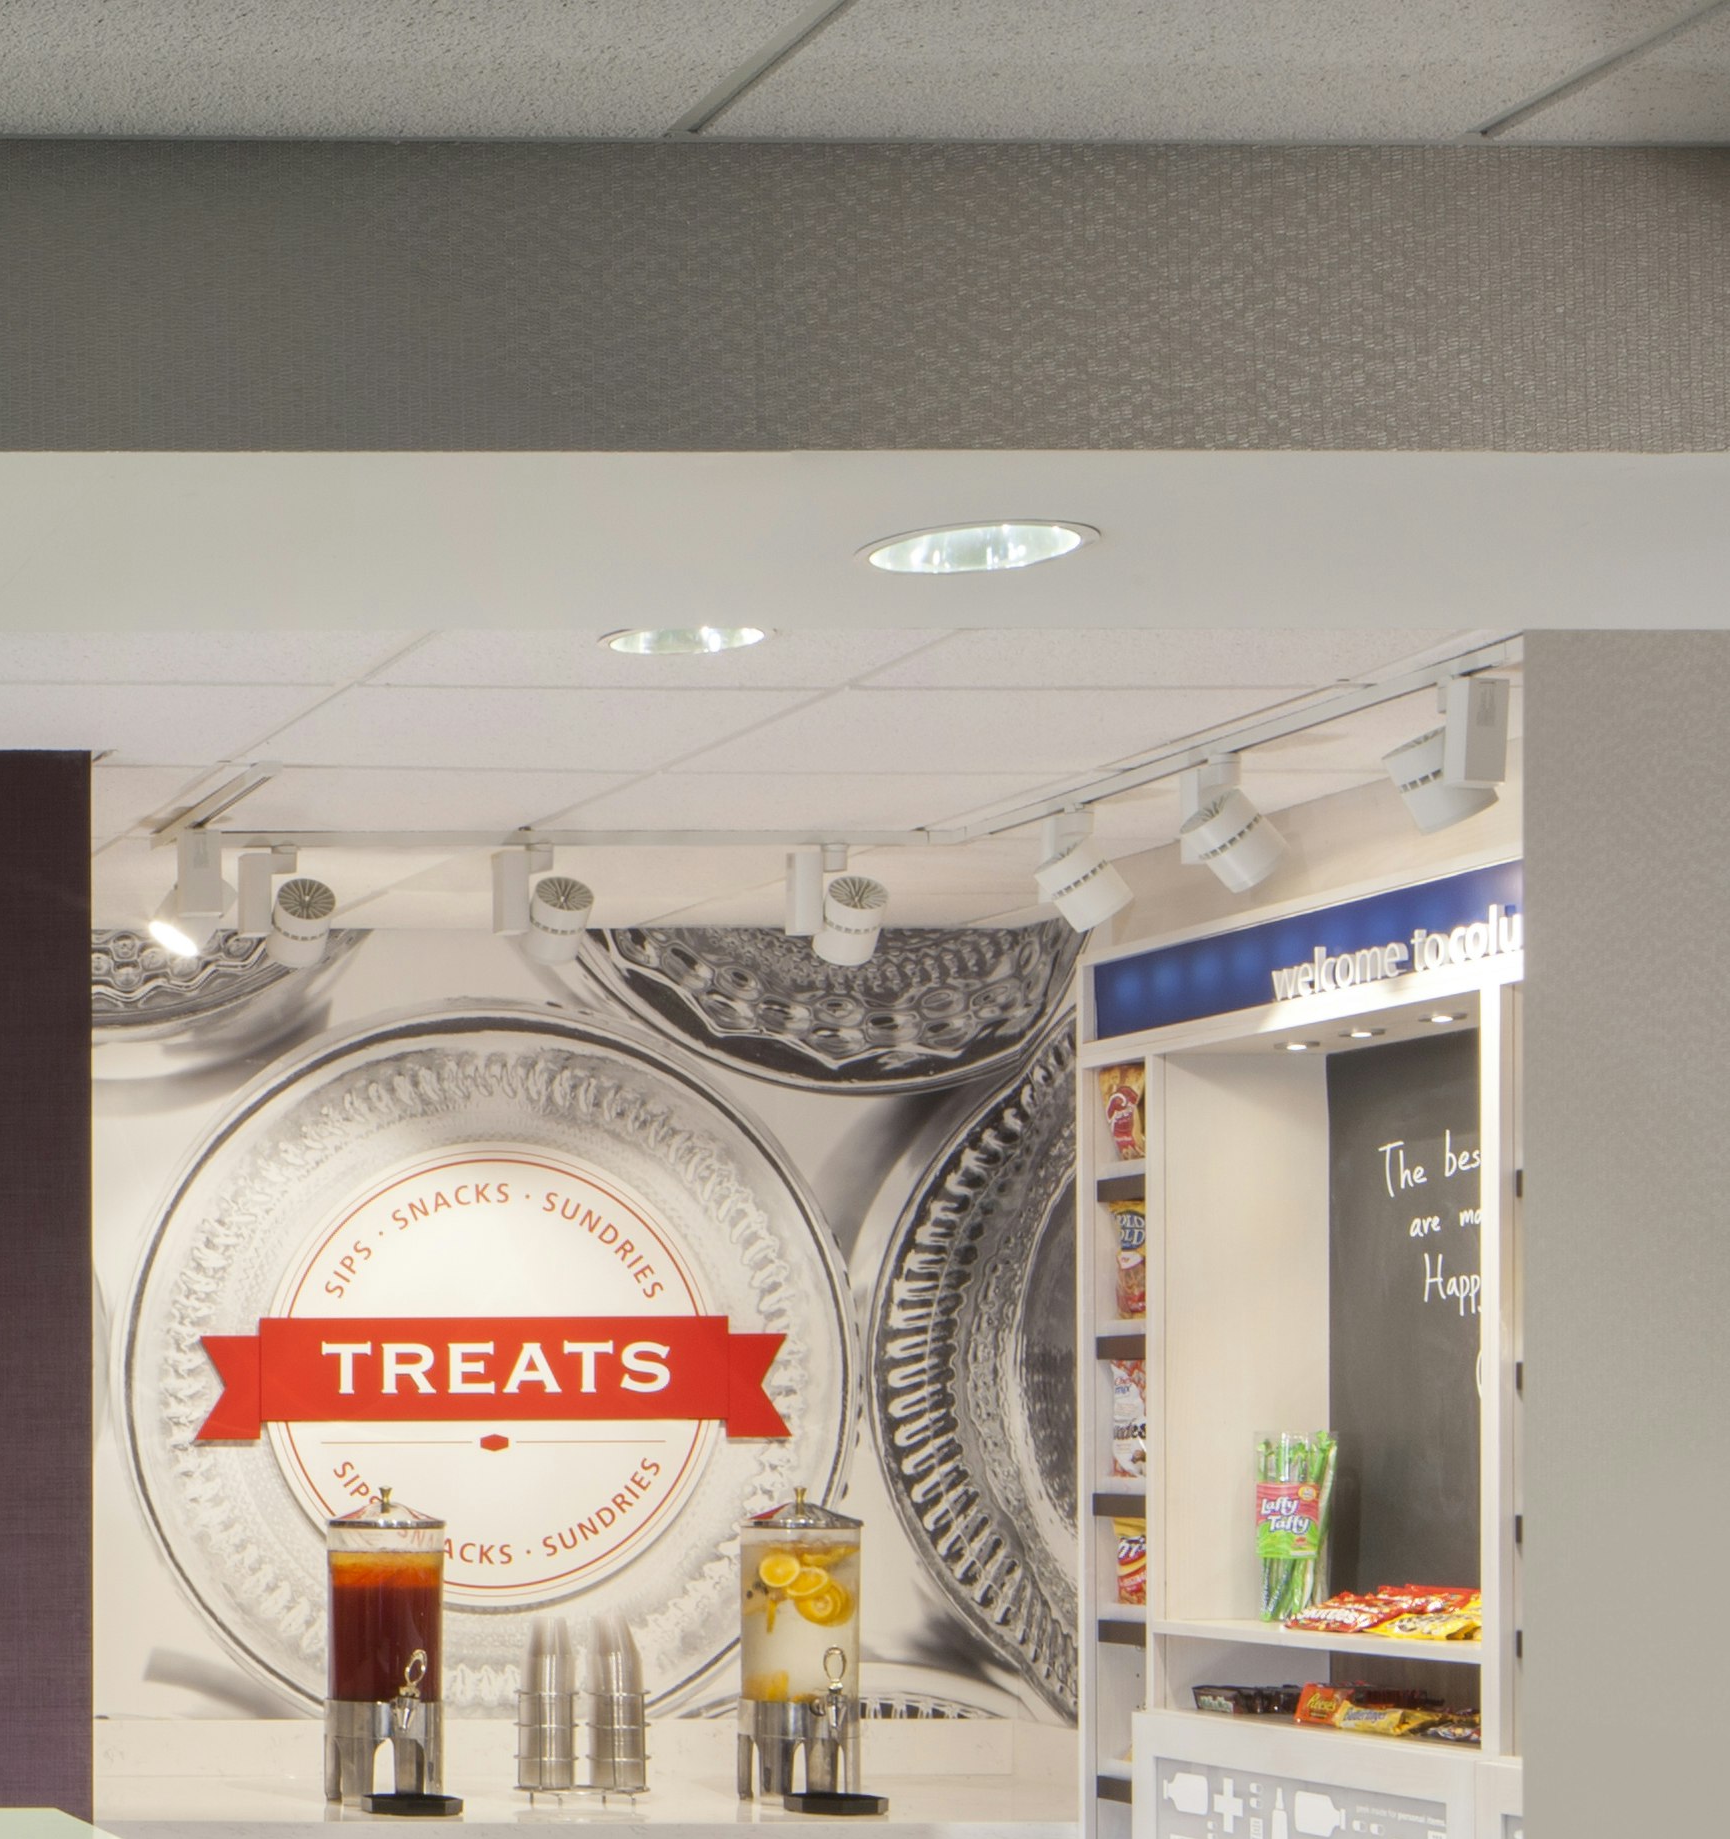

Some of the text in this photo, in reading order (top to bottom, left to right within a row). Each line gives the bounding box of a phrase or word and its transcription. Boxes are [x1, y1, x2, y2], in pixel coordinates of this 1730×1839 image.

[1271, 904, 1523, 1001] welcome to colu
[1378, 1129, 1481, 1197] The bes
[324, 1183, 664, 1300] SIPS SNACKS SUNDRIES
[1409, 1215, 1441, 1238] are
[1423, 1252, 1482, 1317] Happ
[321, 1339, 671, 1395] TREATS
[541, 1457, 661, 1558] SUNDRIES
[1260, 1498, 1300, 1516] Laffy
[1267, 1514, 1311, 1534] Taffy
